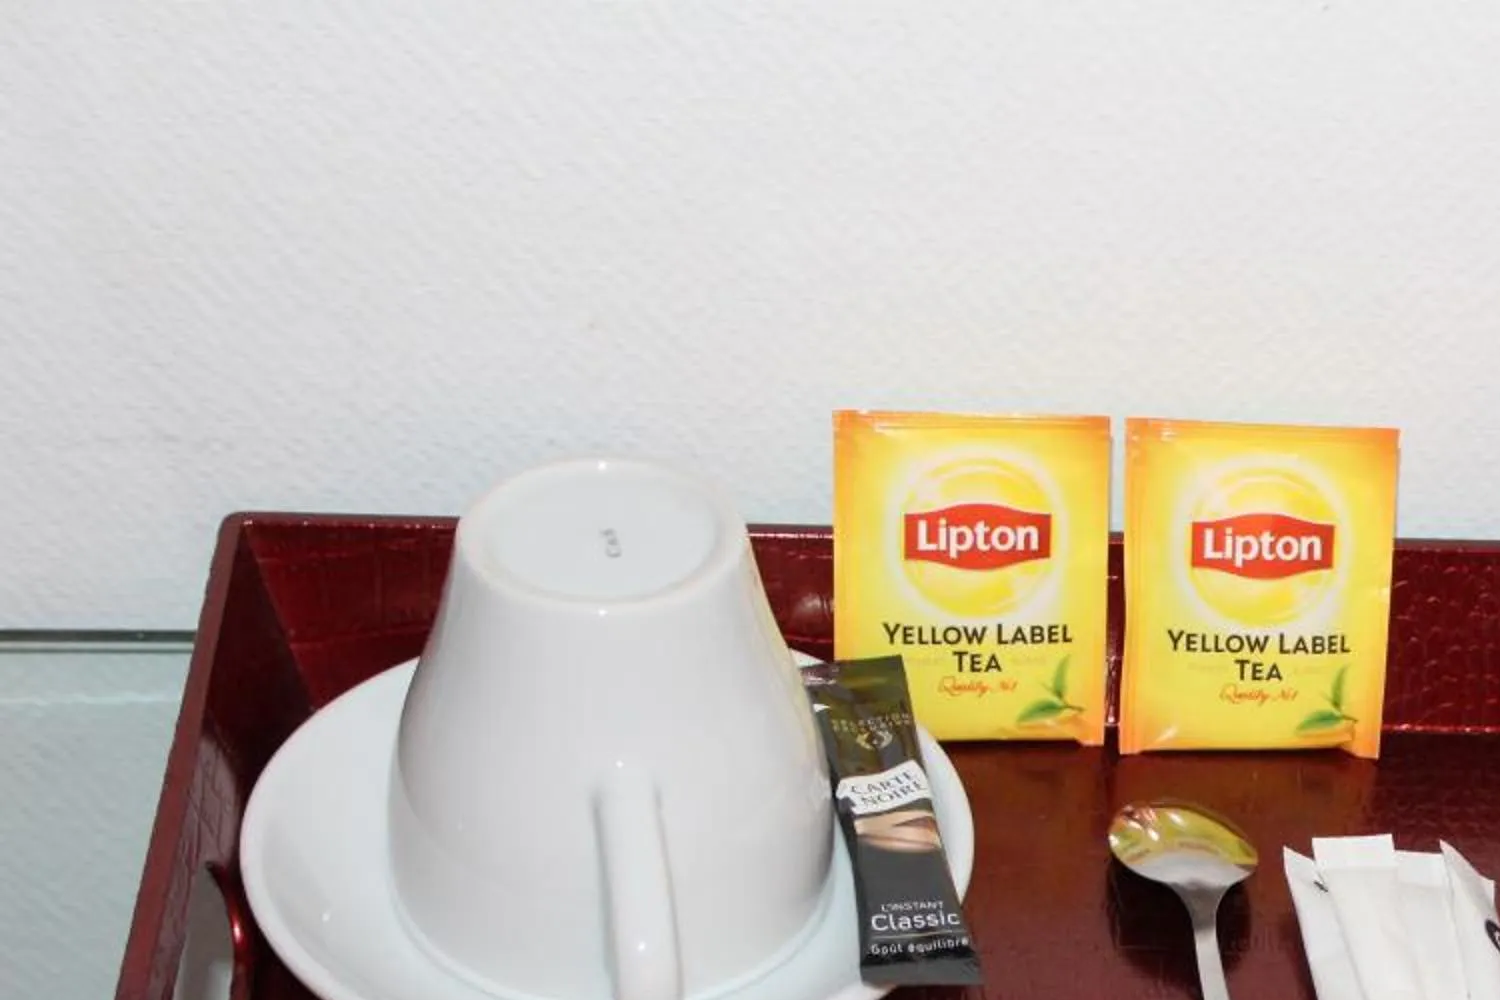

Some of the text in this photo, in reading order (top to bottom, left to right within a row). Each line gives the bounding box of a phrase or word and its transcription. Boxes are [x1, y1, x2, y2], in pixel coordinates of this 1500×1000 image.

[917, 519, 1039, 558] Lipton
[1203, 528, 1322, 568] Lipton
[883, 622, 1073, 645] YELLOW LABEL
[1167, 629, 1351, 655] YELLOW LABEL
[952, 651, 1003, 673] TEA
[1234, 659, 1283, 681] TEA
[871, 909, 960, 931] Classic
